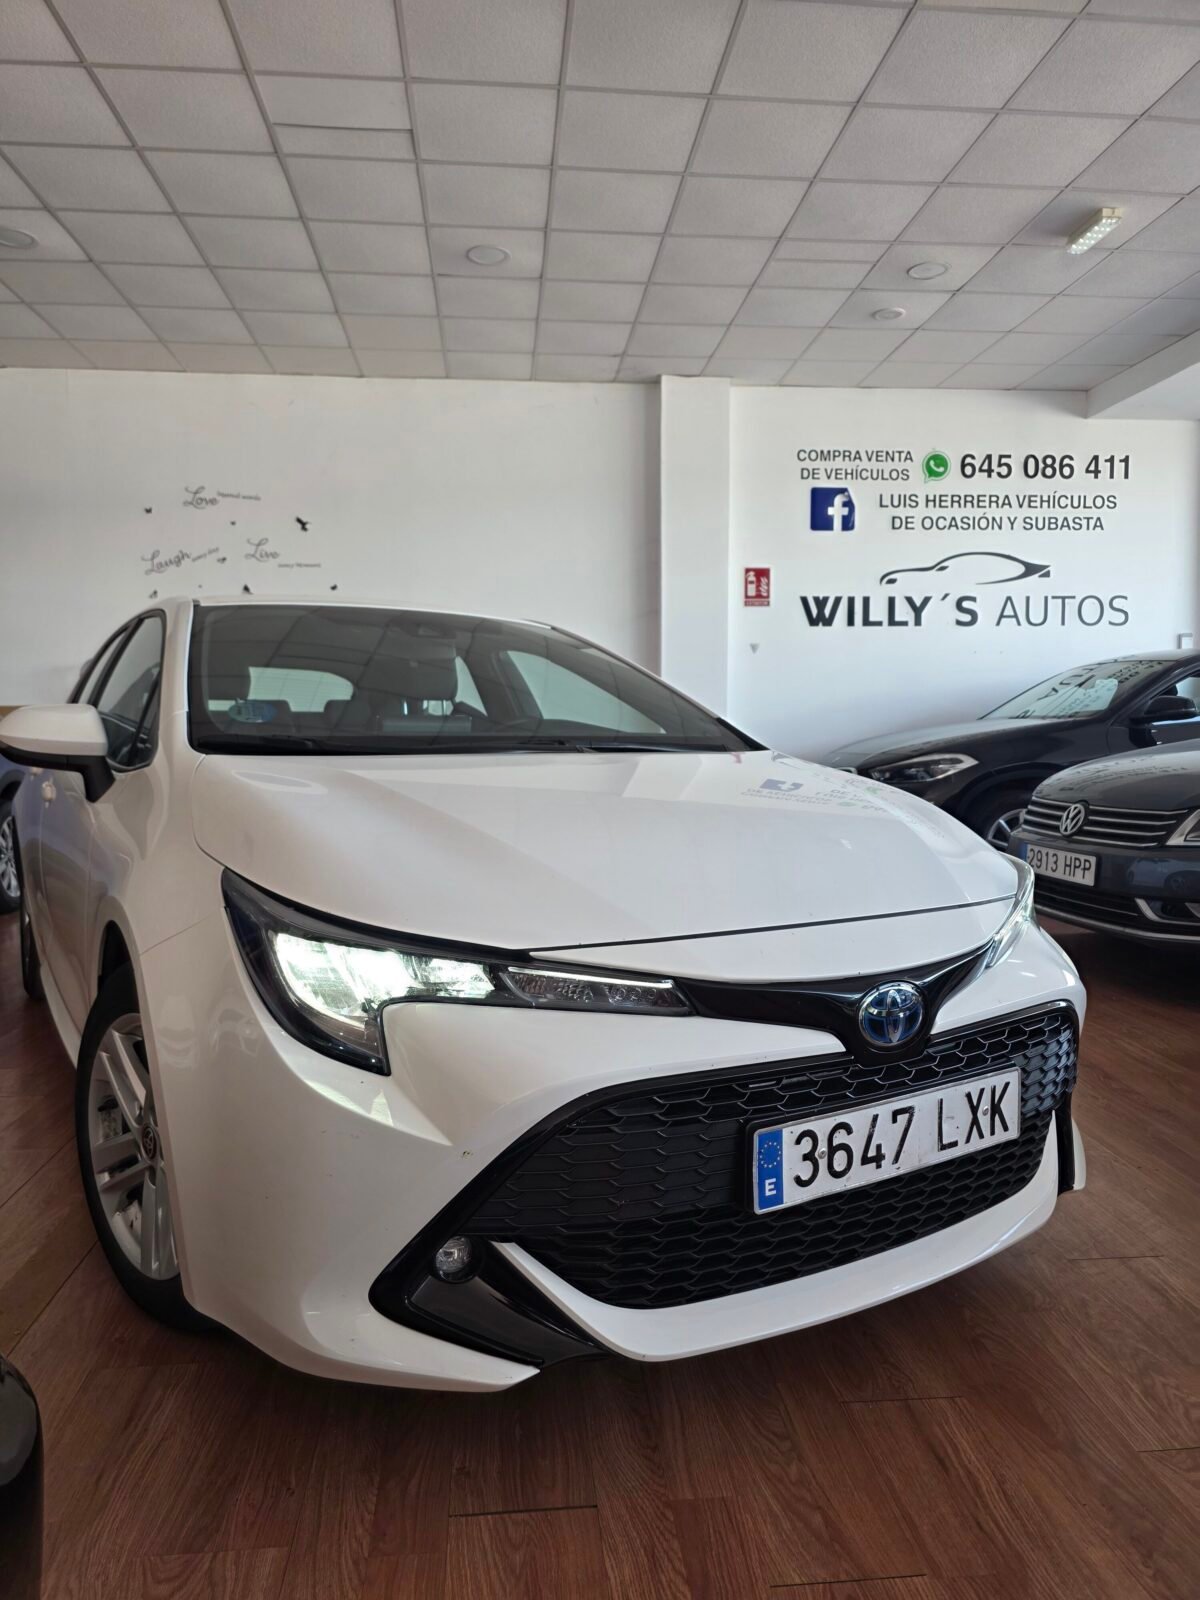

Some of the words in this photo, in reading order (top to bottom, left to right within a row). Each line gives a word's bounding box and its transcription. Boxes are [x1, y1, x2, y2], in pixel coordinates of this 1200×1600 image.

[796, 448, 862, 463] COMPRA
[864, 449, 914, 463] VENTA
[800, 467, 822, 481] DE
[824, 464, 910, 482] VEHÍCULOS
[959, 453, 1013, 480] 645
[1022, 453, 1075, 480] 086
[1084, 454, 1130, 480] 411
[878, 493, 920, 509] LUIS
[924, 493, 1013, 509] HERRERA
[1015, 490, 1118, 510] VEHÍCULOS
[890, 515, 916, 531] DE
[920, 511, 1003, 531] OCASIÓN
[1006, 515, 1018, 531] Y
[1022, 515, 1105, 531] SUBASTA
[994, 594, 1130, 628] AUTOS
[1028, 848, 1059, 873] 2913
[1063, 855, 1092, 880] HPP
[793, 1105, 916, 1188] 3647
[937, 1081, 1011, 1152] LXK
[764, 1178, 777, 1196] E
